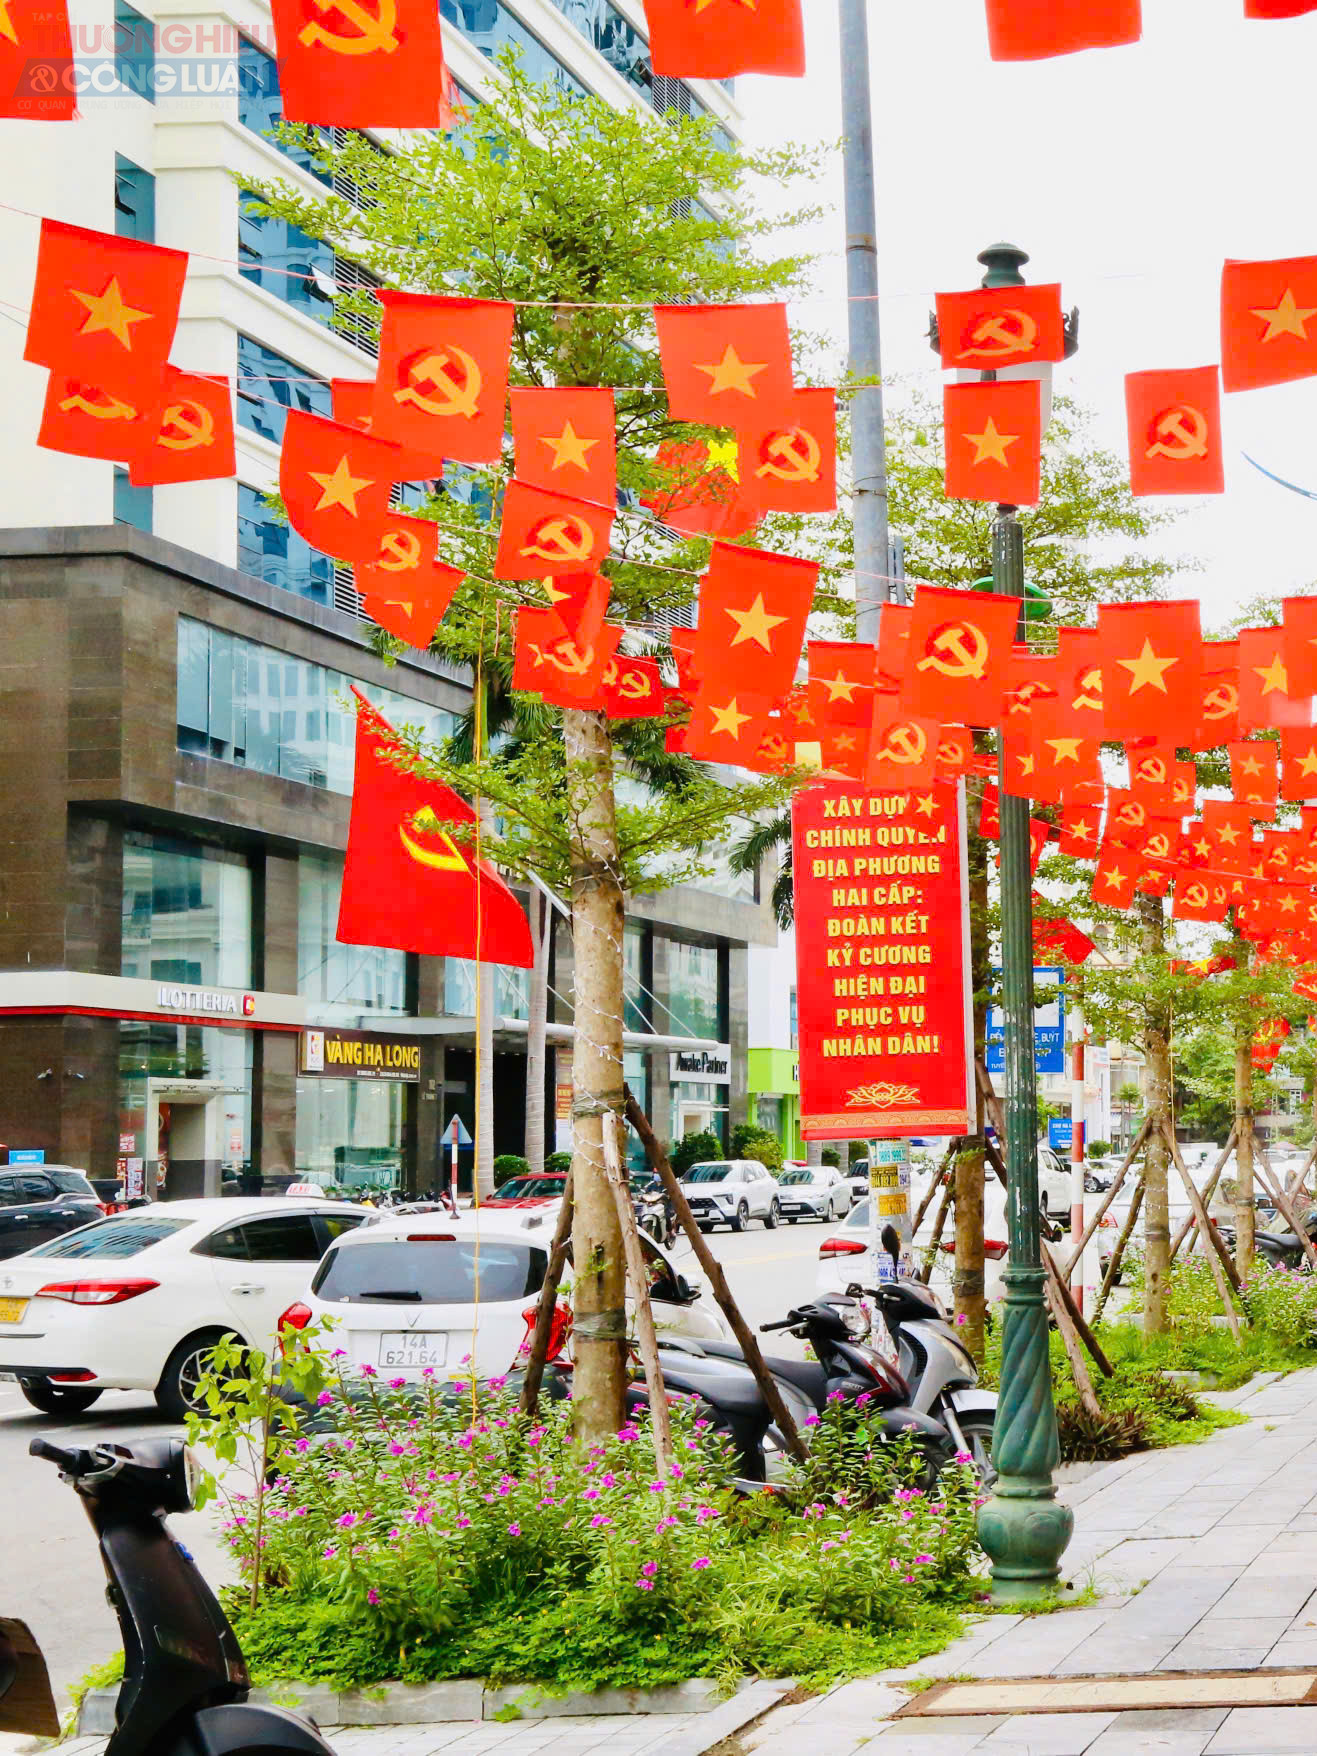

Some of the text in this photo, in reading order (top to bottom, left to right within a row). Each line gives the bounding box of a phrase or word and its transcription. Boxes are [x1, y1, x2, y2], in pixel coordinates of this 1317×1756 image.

[823, 795, 909, 819] XÂY DỰN
[806, 826, 871, 848] CHÍNH
[812, 853, 941, 881] ĐỊA PHƯƠNG
[832, 880, 924, 907] HAI CẤP:
[827, 910, 929, 938] ĐOÀN KẾT
[826, 943, 932, 968] KỶ CƯƠNG
[158, 986, 237, 1013] LOTTERIA
[834, 975, 926, 1000] HIỆN ĐẠI
[836, 1005, 926, 1028] PHỤC VỤ
[326, 1034, 419, 1072] VÀNG HẠ LONG
[822, 1033, 940, 1058] NHÂN DÂN!
[401, 1334, 427, 1349] 14A
[386, 1351, 437, 1364] 621.64
